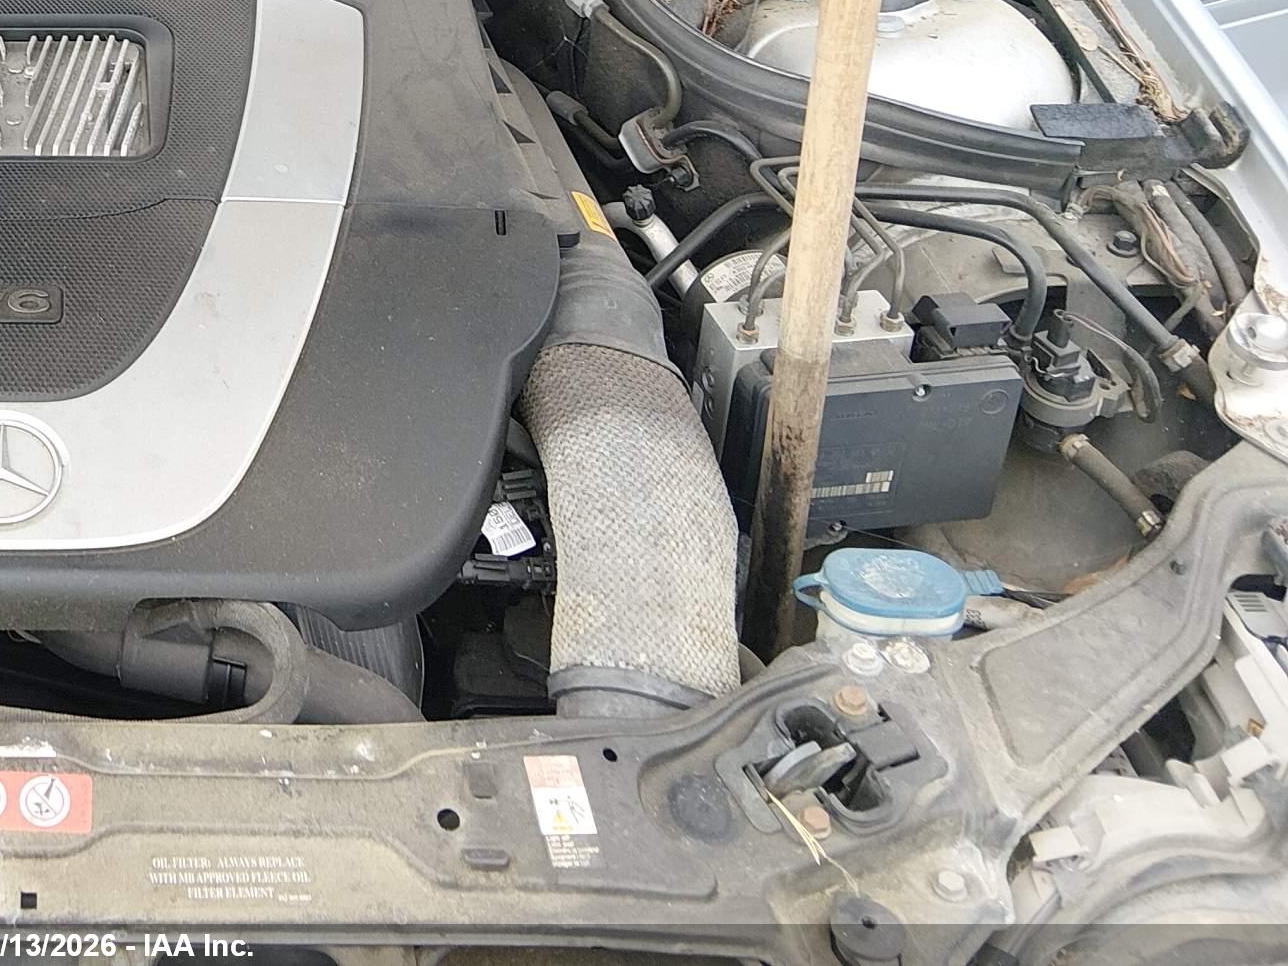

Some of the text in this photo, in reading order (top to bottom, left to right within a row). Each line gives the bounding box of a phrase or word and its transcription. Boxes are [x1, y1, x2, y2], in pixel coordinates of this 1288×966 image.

[152, 857, 171, 869] OIL
[217, 857, 258, 869] ALWAYS
[259, 857, 305, 869] REPLACE
[149, 872, 177, 884] WITH
[197, 872, 250, 883] APPROVED
[251, 872, 290, 883] FLEECE
[292, 871, 311, 883] OIL
[187, 886, 224, 899] FILTER
[226, 886, 275, 899] ELEMENT
